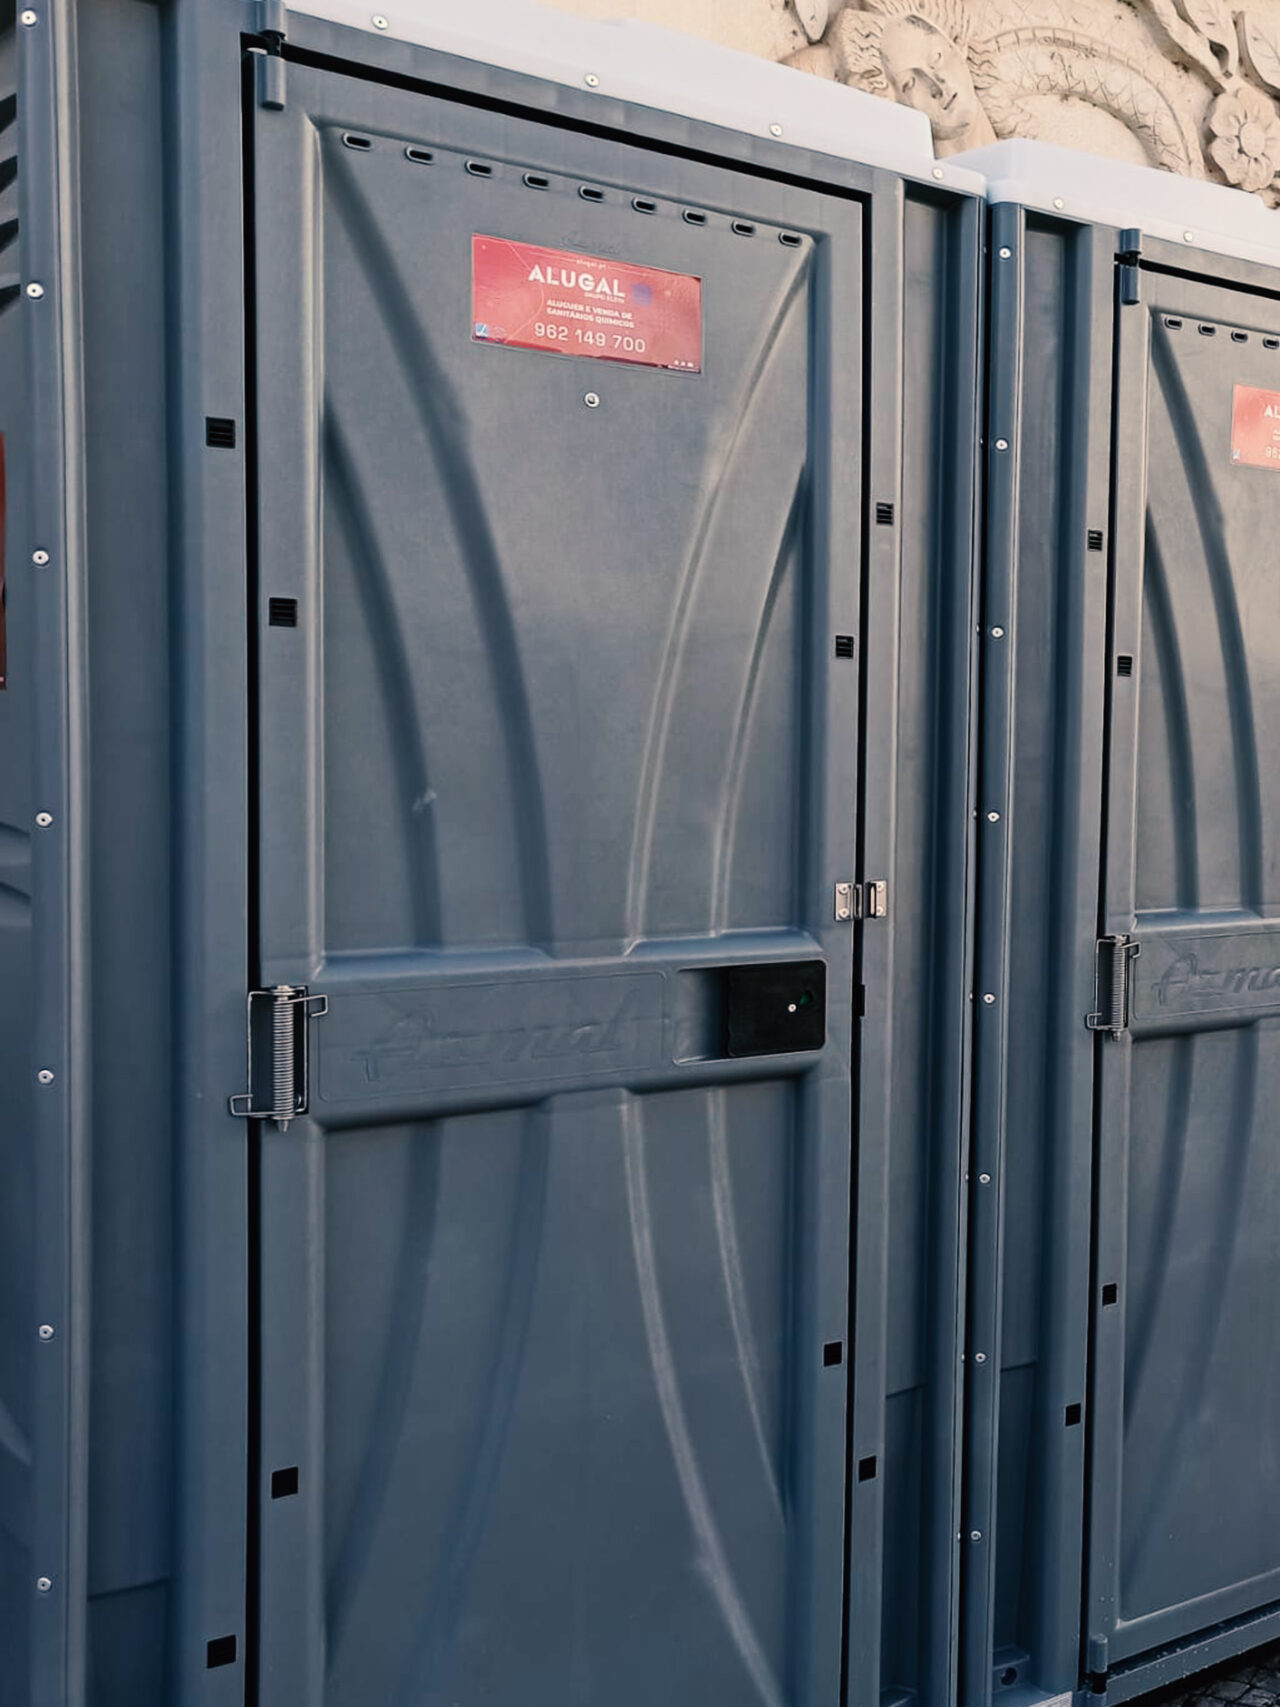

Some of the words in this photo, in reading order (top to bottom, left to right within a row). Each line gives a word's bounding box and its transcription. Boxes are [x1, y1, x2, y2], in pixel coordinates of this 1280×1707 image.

[528, 264, 626, 297] ALUGAL
[592, 306, 620, 318] VENDA
[620, 311, 633, 320] DE
[534, 322, 568, 341] 962
[575, 328, 606, 347] 149
[612, 334, 646, 353] 700
